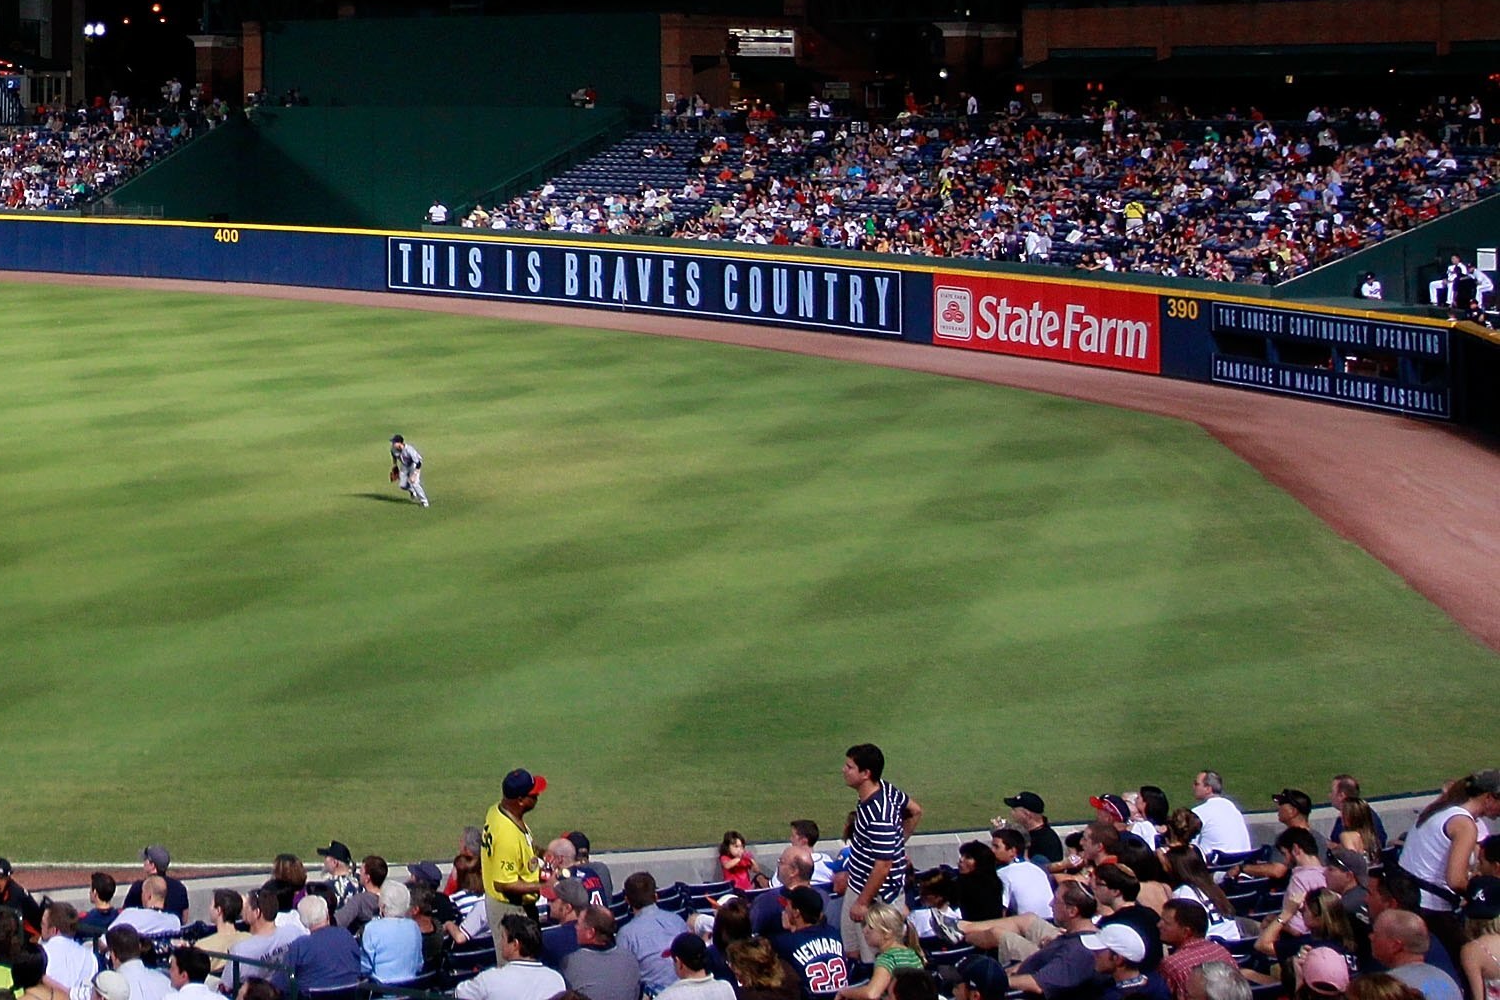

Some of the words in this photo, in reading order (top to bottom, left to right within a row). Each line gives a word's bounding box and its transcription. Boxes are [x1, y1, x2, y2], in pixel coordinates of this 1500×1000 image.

[214, 228, 240, 243] 400
[399, 243, 481, 289] THIS
[506, 249, 541, 293] IS
[564, 252, 701, 307] BRAVES
[724, 264, 890, 327] COUNTRY
[1167, 298, 1199, 319] 390
[1218, 307, 1236, 328] THE
[1241, 311, 1284, 333] LONGEST
[1289, 318, 1369, 345] CONTINUOUSLY
[1375, 328, 1440, 355] OPERATING
[1216, 360, 1273, 385] FRANCHISE
[1279, 369, 1290, 387] IN
[1295, 371, 1330, 394] MAJOR
[1336, 378, 1377, 402] LEAGUE
[1383, 386, 1444, 413] BASEBALL
[500, 860, 515, 871] 736
[792, 937, 843, 966] HEYWARD
[805, 956, 847, 994] 22
